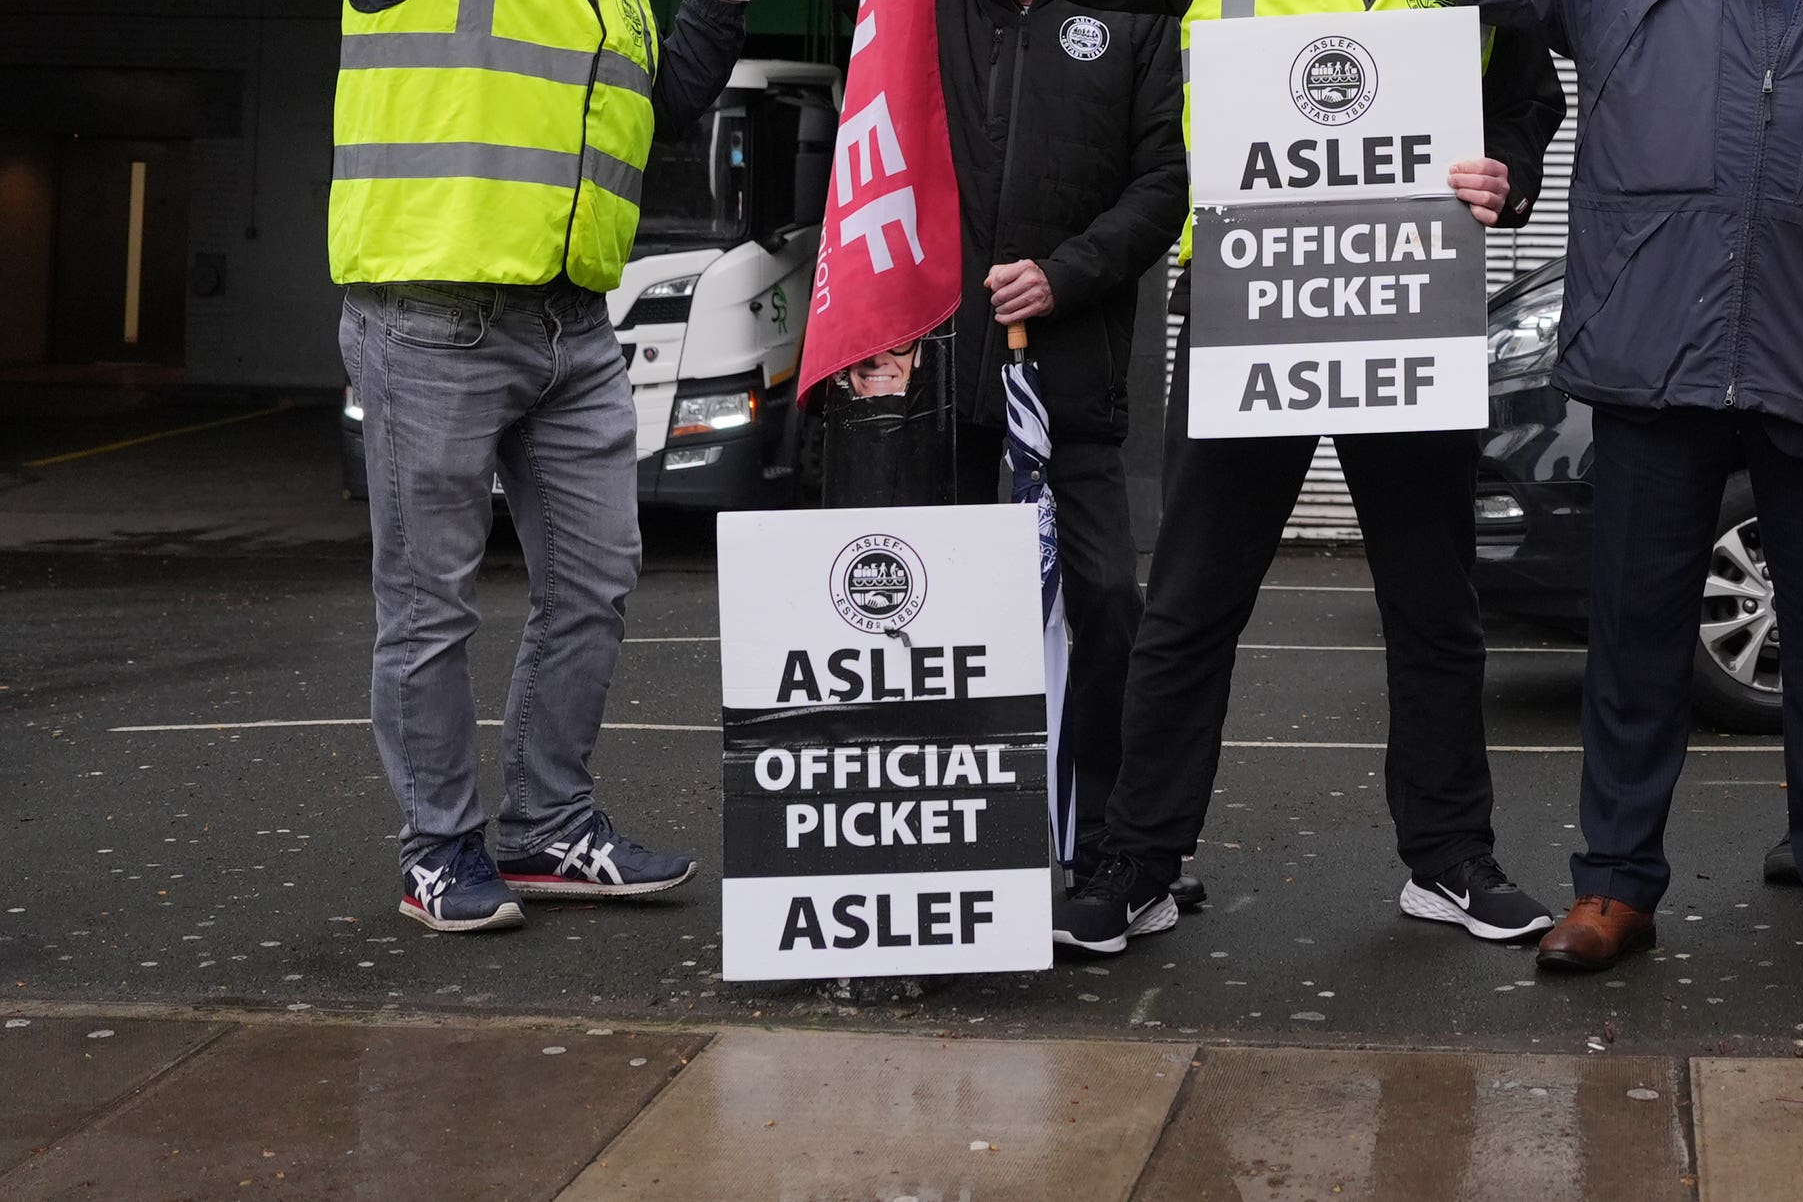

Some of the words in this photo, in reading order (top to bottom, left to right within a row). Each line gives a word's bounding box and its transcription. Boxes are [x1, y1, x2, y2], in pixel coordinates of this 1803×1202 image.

[1312, 39, 1354, 53] ASLEF
[1345, 94, 1371, 119] 1880
[1239, 134, 1432, 190] ASLEF
[1219, 220, 1457, 269] OFFICIAL
[1247, 273, 1430, 320] PICKET
[1238, 356, 1435, 412] ASLEF
[854, 537, 901, 553] ASLEF
[891, 599, 920, 627] 1880
[775, 645, 987, 702] ASLEF
[754, 744, 1016, 791] OFFICIAL
[785, 799, 987, 848] PICKET
[778, 890, 994, 951] ASLEF
